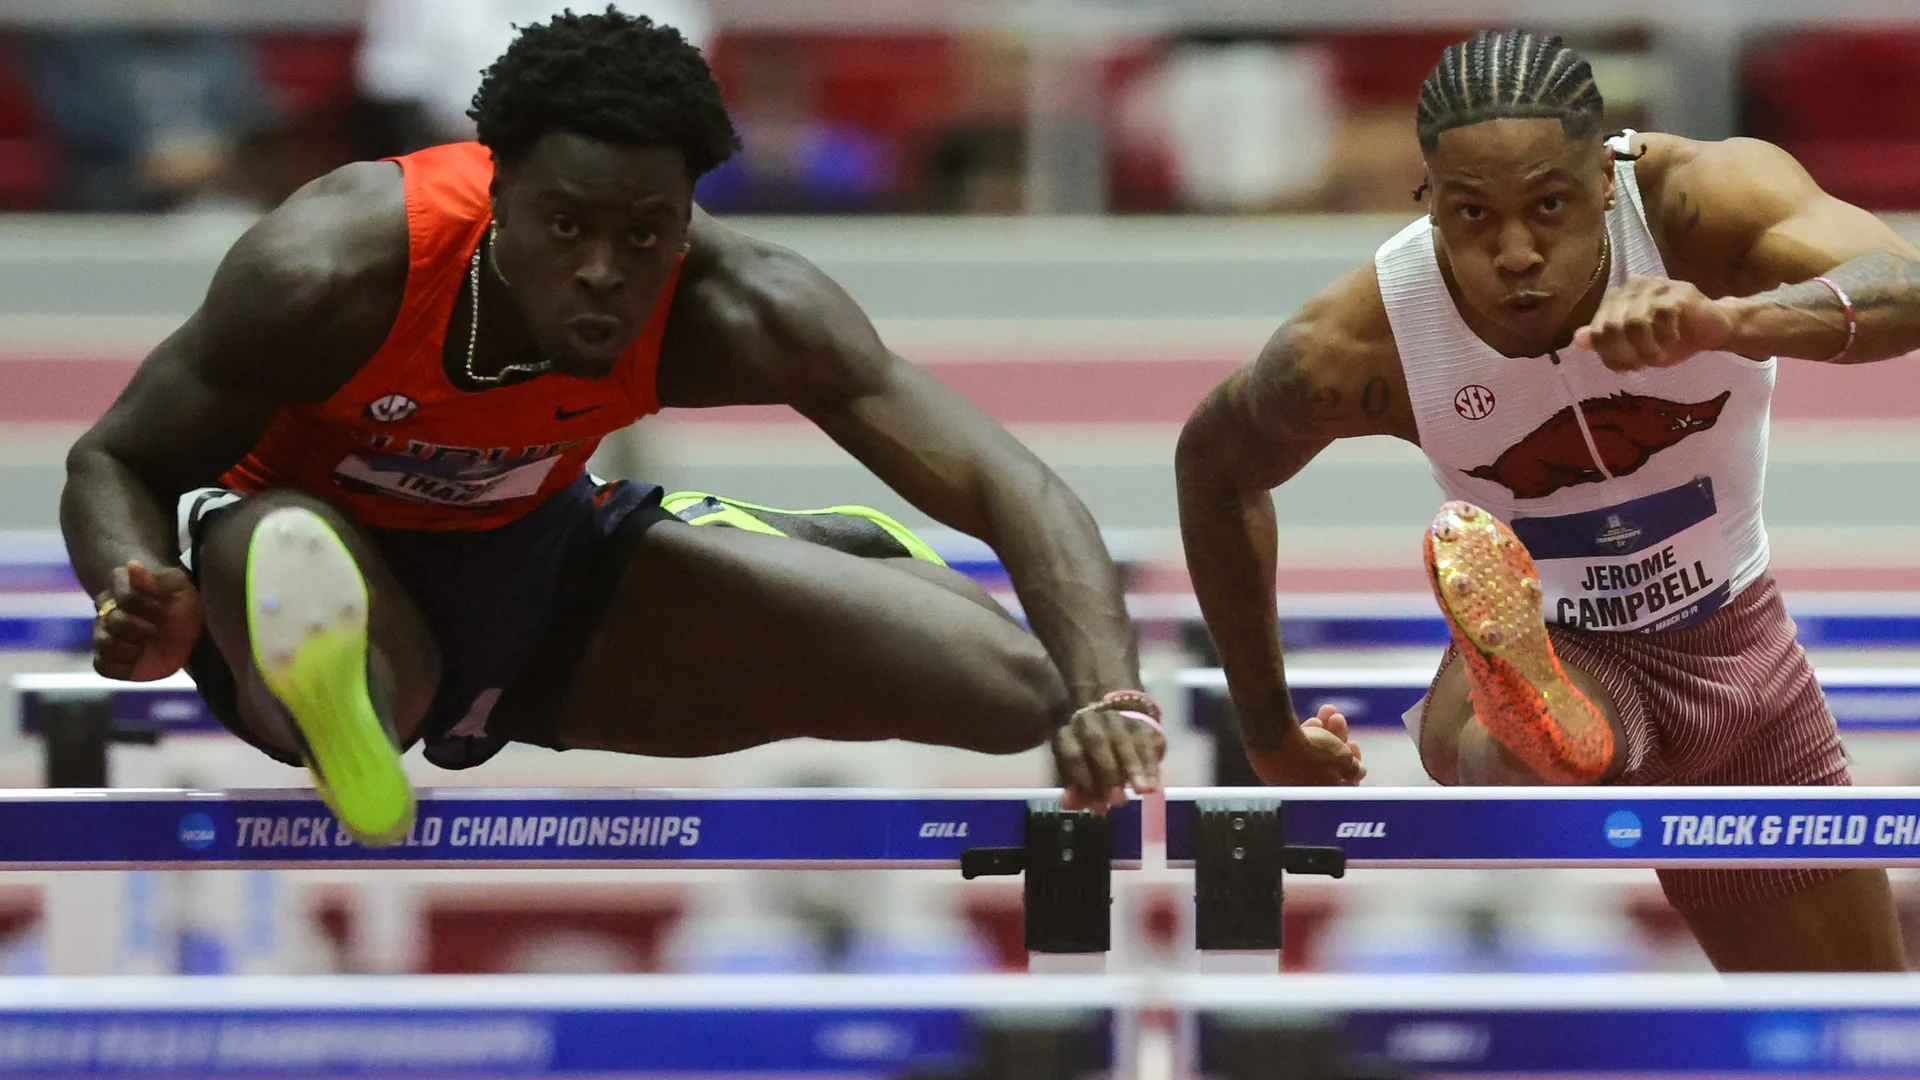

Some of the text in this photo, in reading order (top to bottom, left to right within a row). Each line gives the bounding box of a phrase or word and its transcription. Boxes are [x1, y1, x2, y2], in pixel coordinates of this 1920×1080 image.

[1455, 386, 1494, 419] SEC
[1581, 545, 1677, 591] JEROME
[1556, 560, 1714, 628] CAMPBELL
[235, 816, 332, 847] TRACK
[450, 816, 701, 847] CHAMPIONSHIPS
[919, 822, 969, 838] GILL
[1335, 821, 1386, 838] GILL
[1661, 815, 1757, 845] TRACK
[1759, 815, 1783, 845] &
[1786, 815, 1868, 845] FIELD
